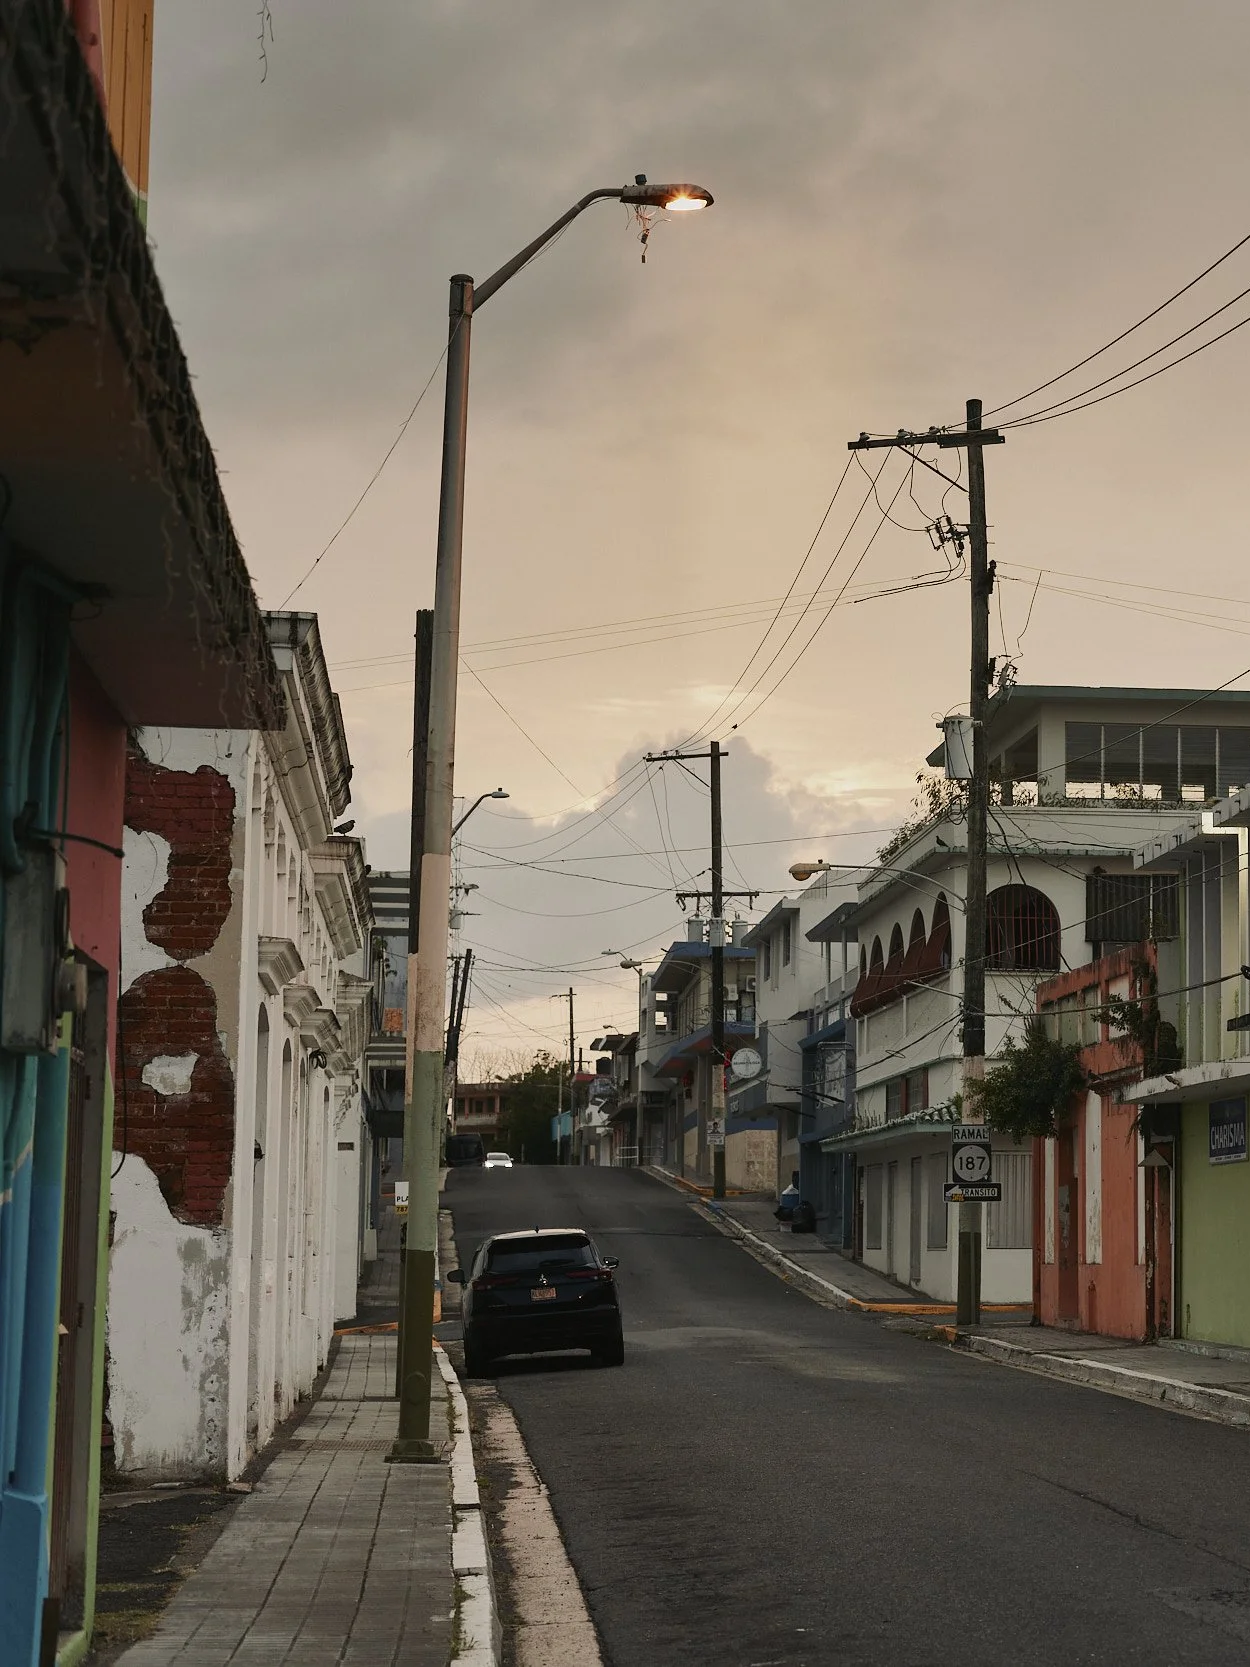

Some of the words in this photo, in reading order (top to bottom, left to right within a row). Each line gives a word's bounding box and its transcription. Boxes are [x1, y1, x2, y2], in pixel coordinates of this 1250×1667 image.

[954, 1128, 988, 1140] RAMAL
[1210, 1121, 1245, 1150] CHARISMA
[959, 1156, 986, 1171] 187
